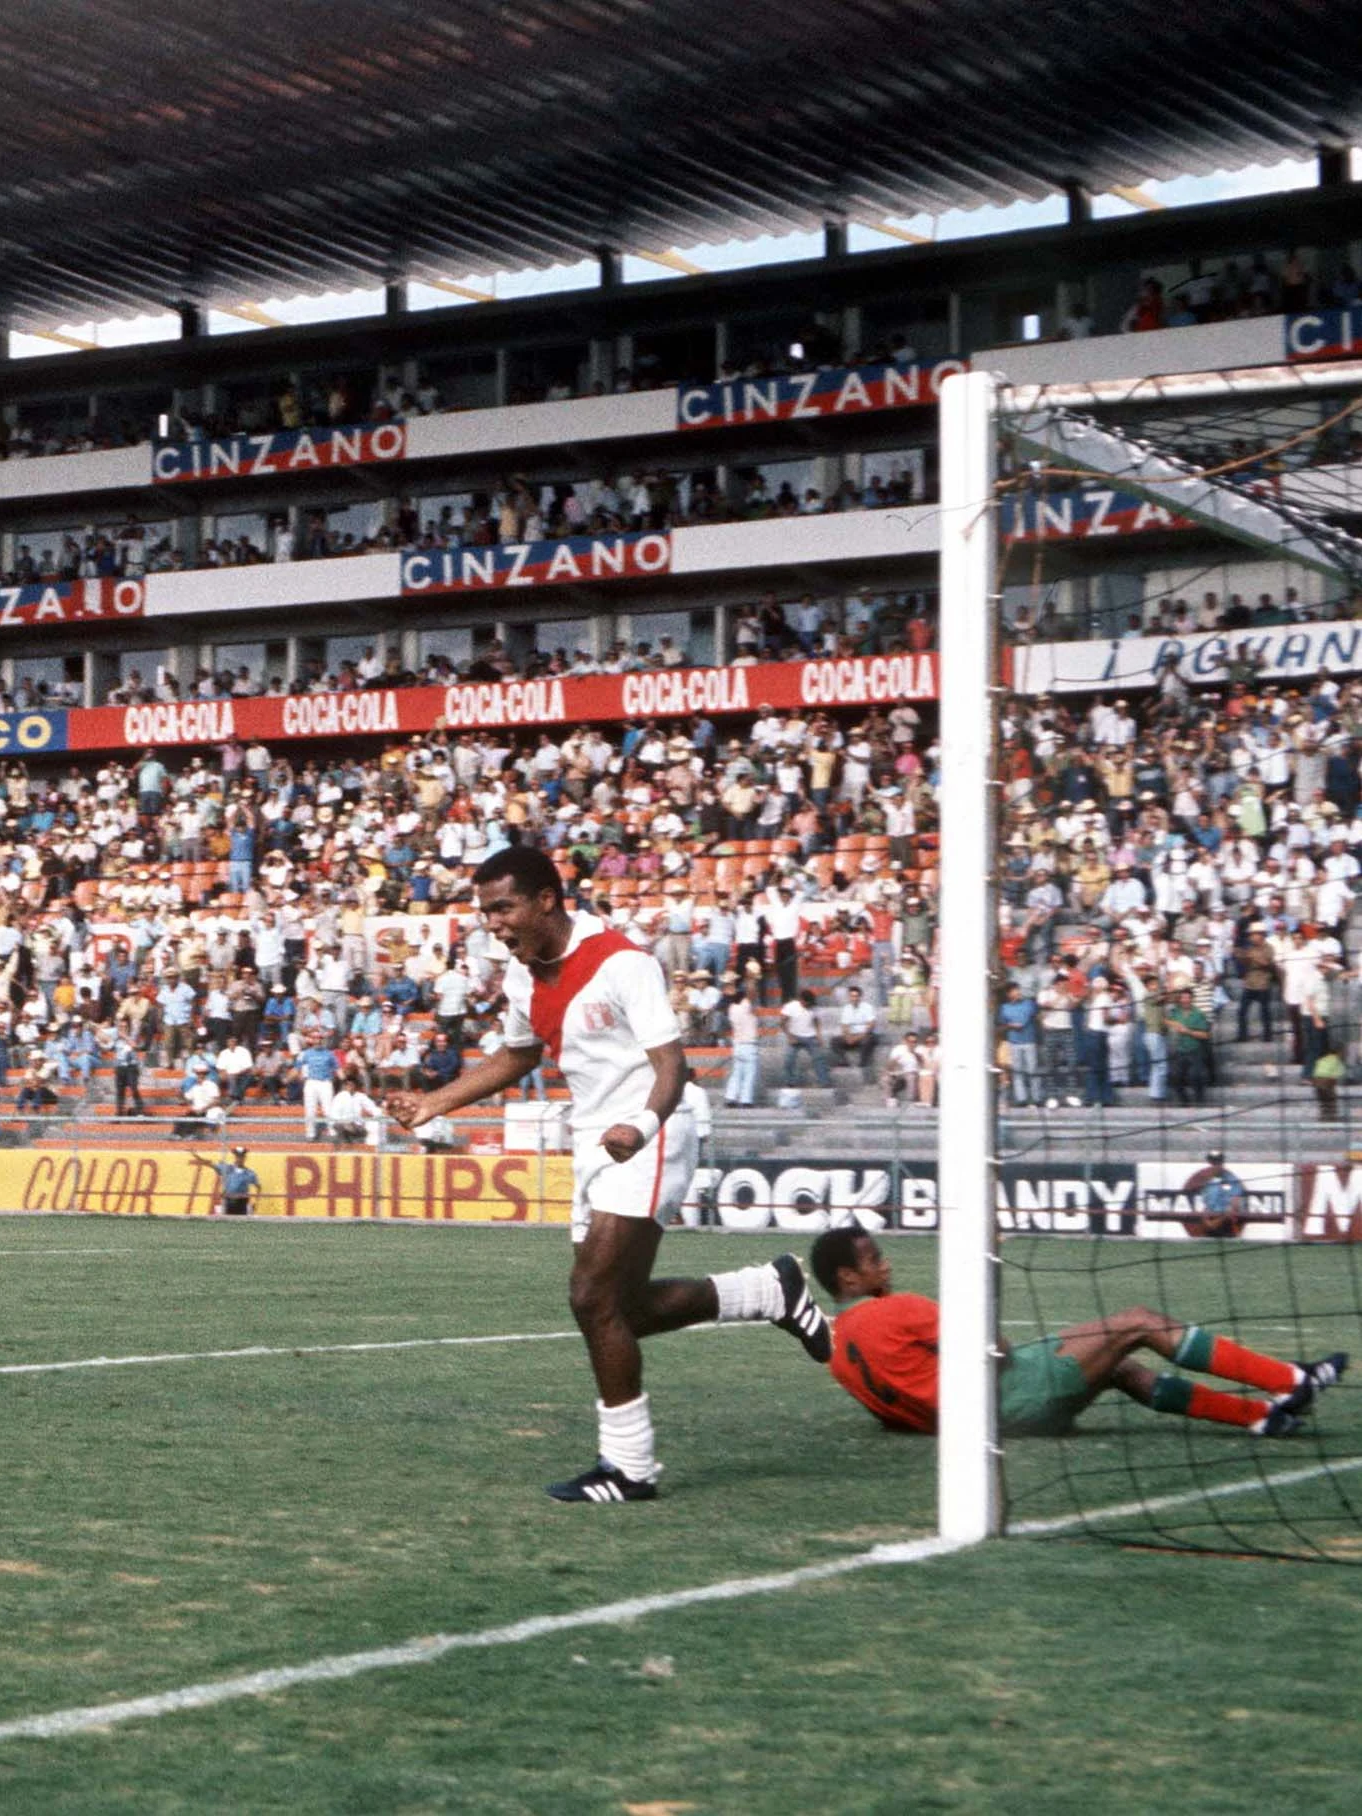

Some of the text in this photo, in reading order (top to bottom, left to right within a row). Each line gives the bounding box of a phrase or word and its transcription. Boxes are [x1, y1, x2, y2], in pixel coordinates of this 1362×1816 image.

[155, 424, 403, 478] CINZANO
[404, 535, 669, 589] CINZANO
[124, 702, 235, 745] COCA-COLA
[283, 691, 399, 735] COCA-COLA
[444, 679, 565, 726] COCA-COLA
[622, 668, 749, 715] COCA-COLA
[23, 1156, 158, 1215] COLOR
[285, 1155, 529, 1222] PHILIPS
[902, 1178, 1133, 1231] BNDY
[1147, 1194, 1282, 1213] MANI
